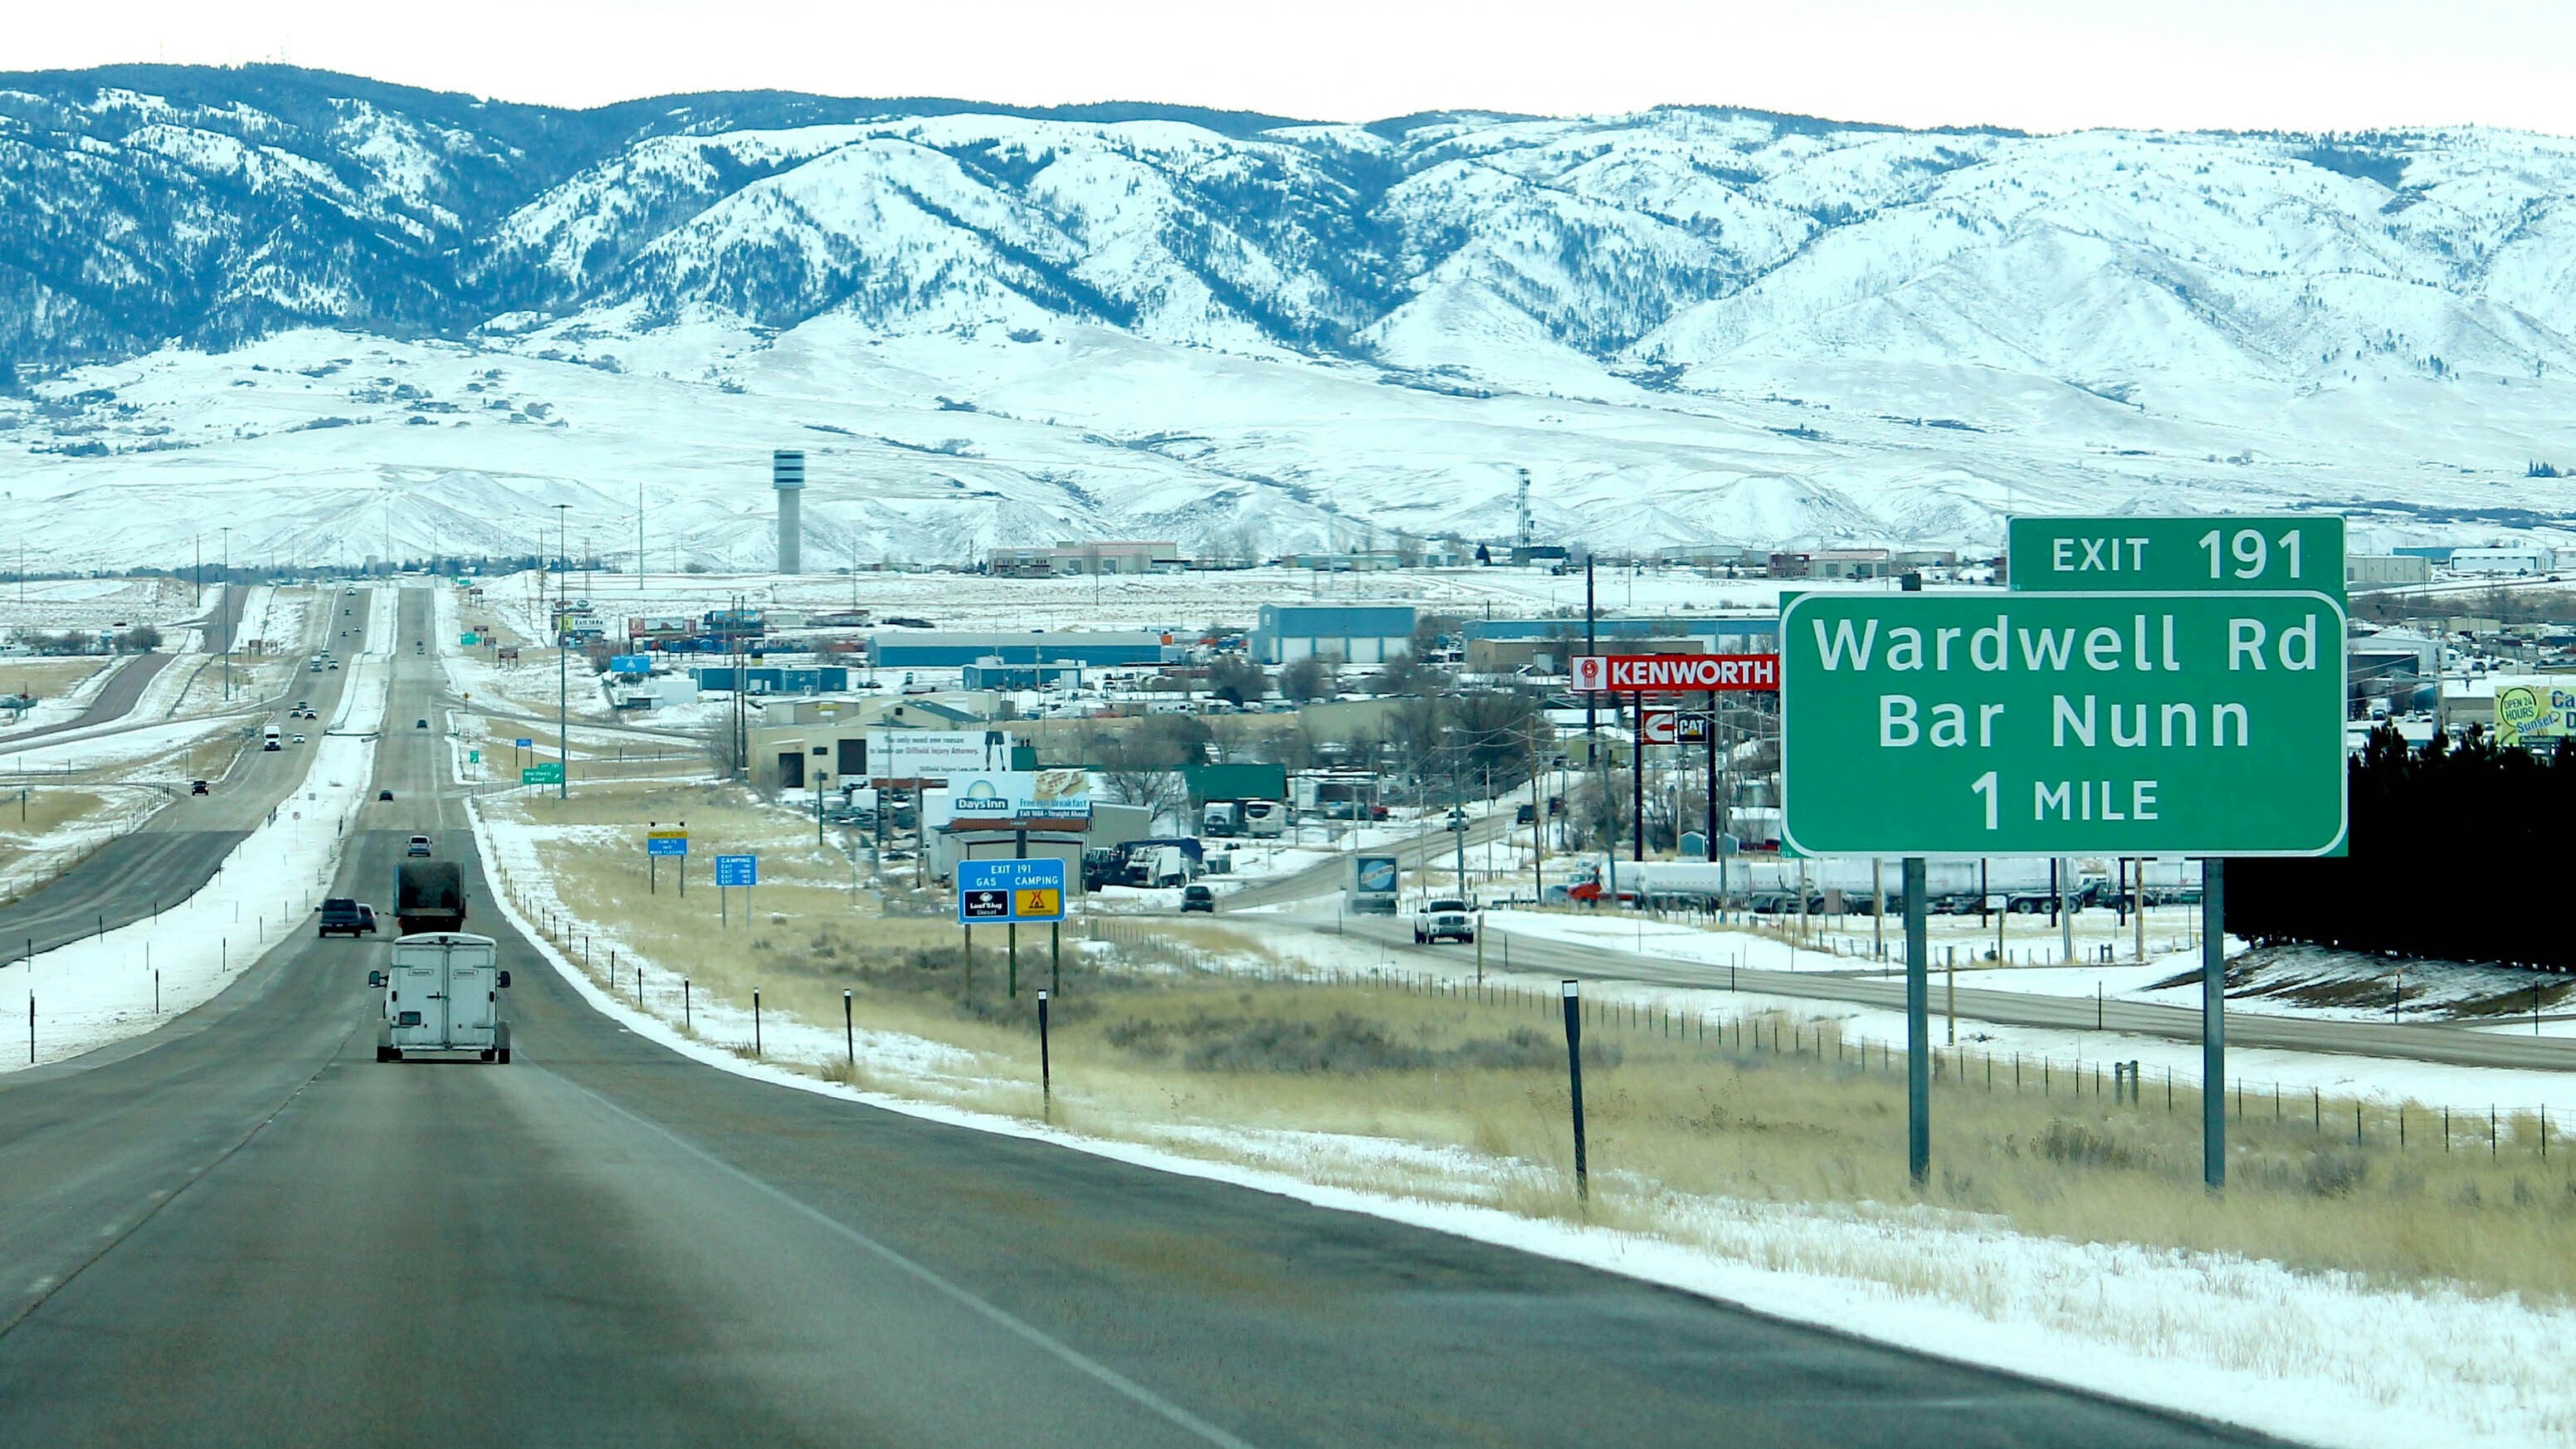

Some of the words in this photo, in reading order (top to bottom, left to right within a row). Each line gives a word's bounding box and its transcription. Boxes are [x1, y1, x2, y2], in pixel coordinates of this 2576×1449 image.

[2053, 538, 2149, 571] EXIT
[2198, 529, 2300, 578] 191
[1812, 614, 2180, 671] Wardwell
[2229, 614, 2316, 671] Rd
[1612, 661, 1773, 685] KENWORTH
[2504, 700, 2523, 710] OPEN
[2524, 697, 2533, 706] 24
[1880, 695, 2004, 747] Bar
[2053, 695, 2248, 746] Nunn
[2505, 707, 2535, 721] HOURS
[1679, 720, 1705, 735] CAT
[2516, 714, 2554, 733] Sunset
[958, 799, 985, 810] Days
[987, 799, 1006, 808] Inn
[1020, 798, 1035, 807] Free
[1037, 798, 1050, 807] Hot
[1051, 798, 1087, 807] Breakfast
[1972, 771, 1998, 829] 1
[2035, 781, 2158, 820] MILE
[1048, 810, 1070, 818] Straight
[991, 865, 1010, 874] EXIT
[1017, 864, 1031, 873] 191
[976, 878, 997, 886] GAS
[1015, 876, 1058, 886] CAMPING
